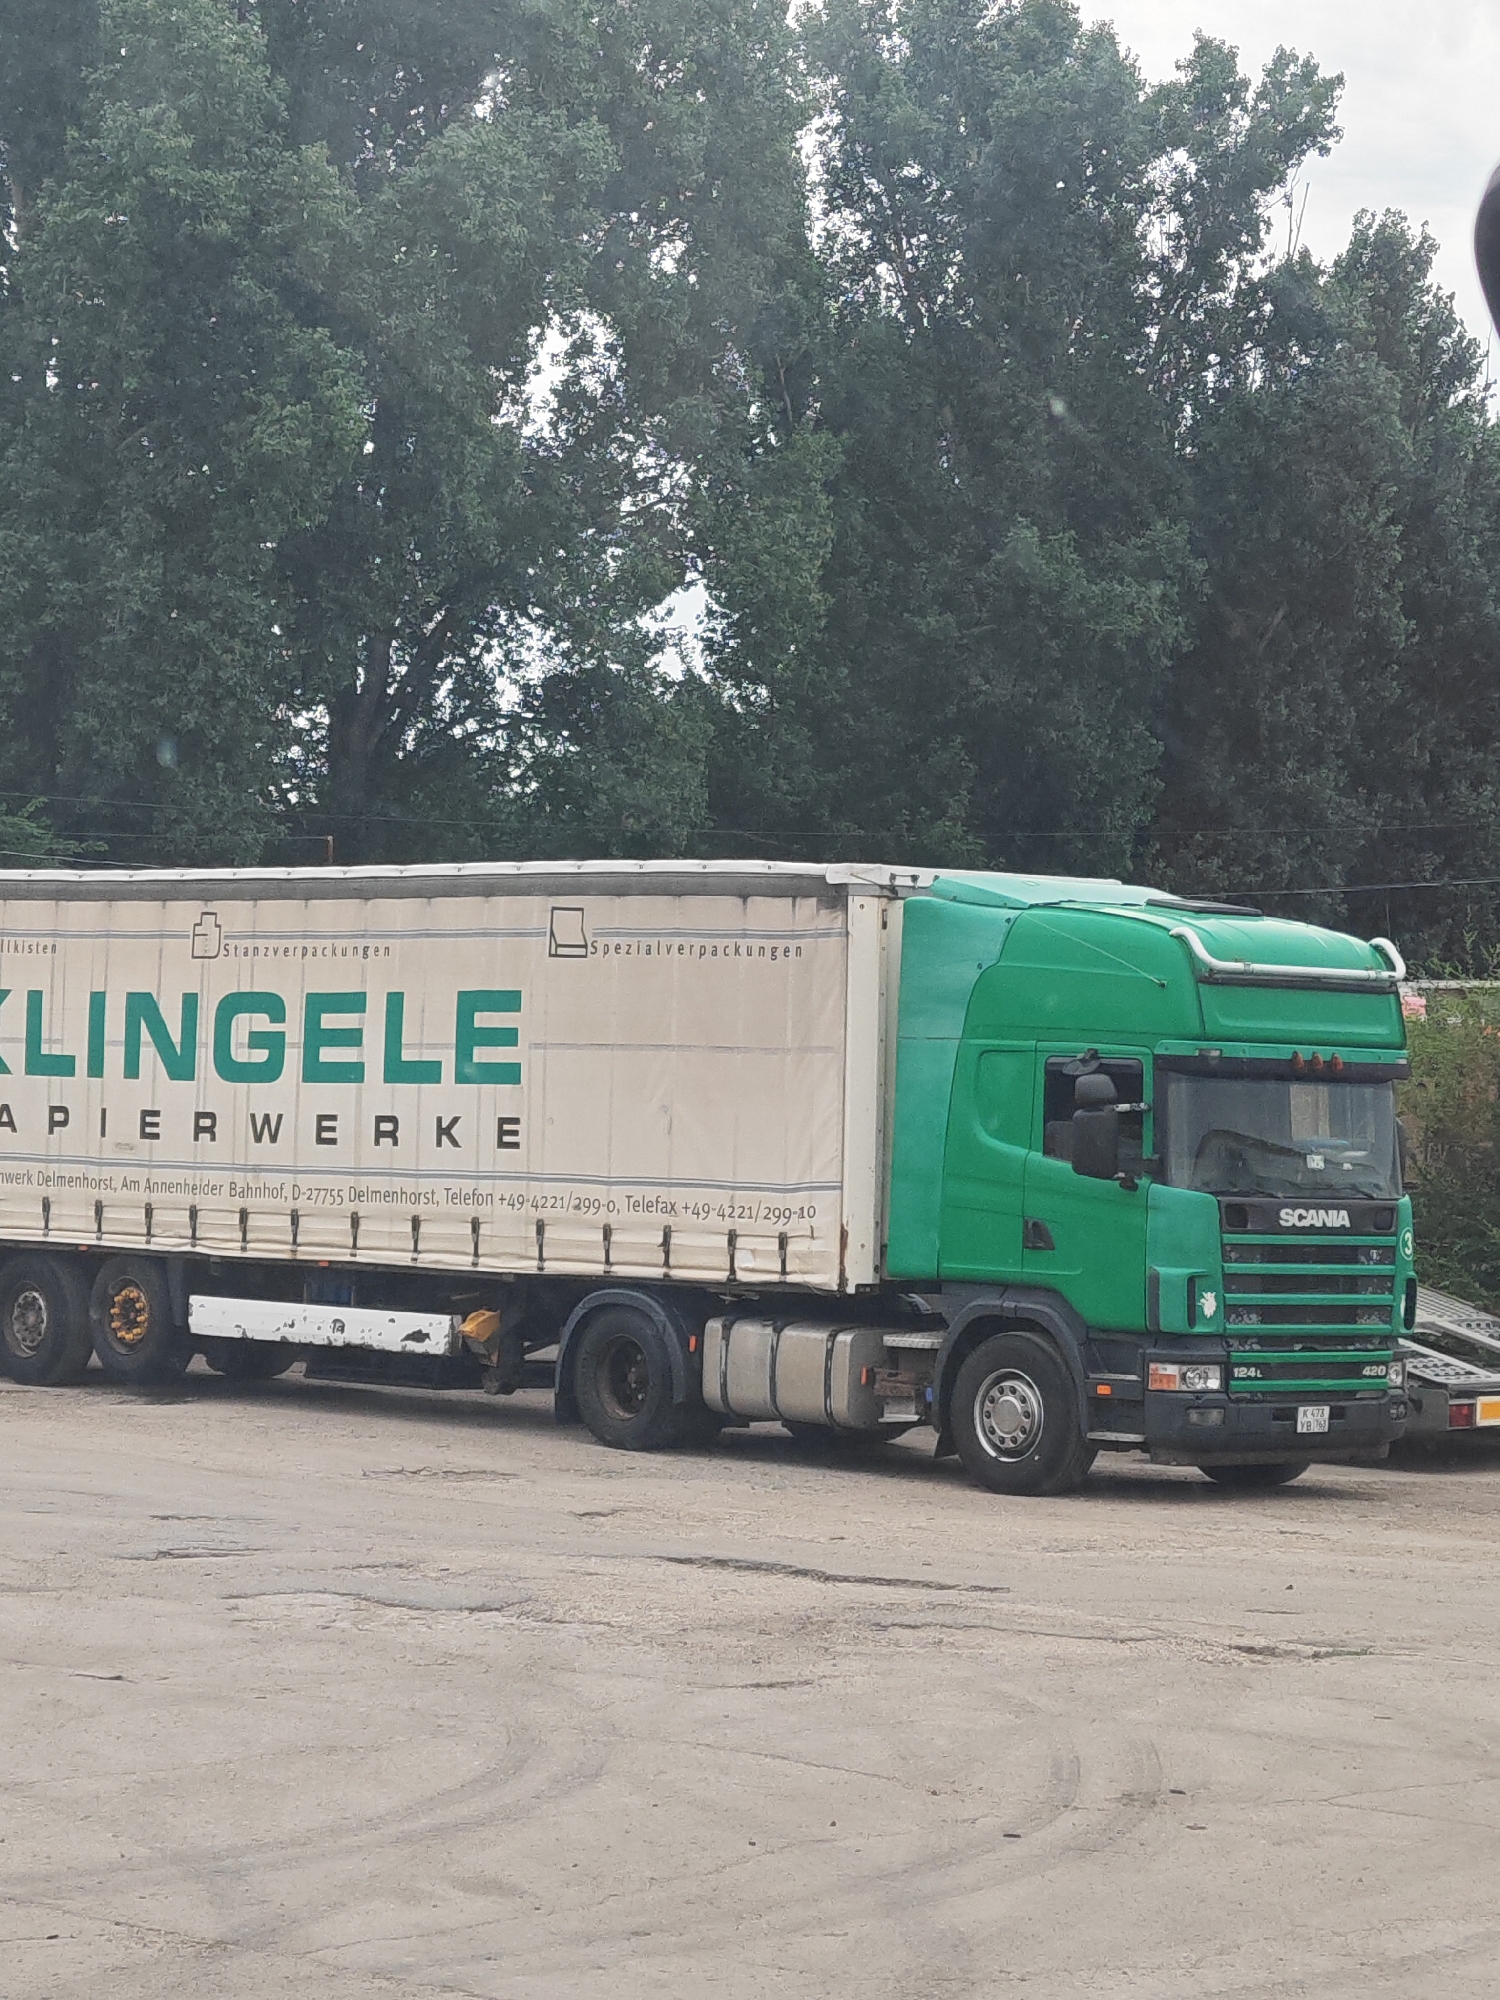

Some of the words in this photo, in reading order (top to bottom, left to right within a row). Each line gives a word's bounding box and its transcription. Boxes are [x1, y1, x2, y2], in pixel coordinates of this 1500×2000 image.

[222, 943, 391, 960] Stanzverpackungen
[589, 939, 803, 961] Spezialverpackungen
[0, 988, 522, 1085] LINGELE
[36, 1170, 118, 1193] Delmenhorst,
[120, 1175, 140, 1192] Am
[143, 1177, 224, 1197] Annenheider
[229, 1181, 288, 1203] Bahnhof,
[292, 1183, 344, 1206] D-27755
[348, 1185, 440, 1208] Delmenhorst,
[443, 1187, 494, 1207] Telefon
[624, 1194, 678, 1215] Telefax
[1278, 1208, 1351, 1228] SCANIA
[1362, 1365, 1387, 1376] 420
